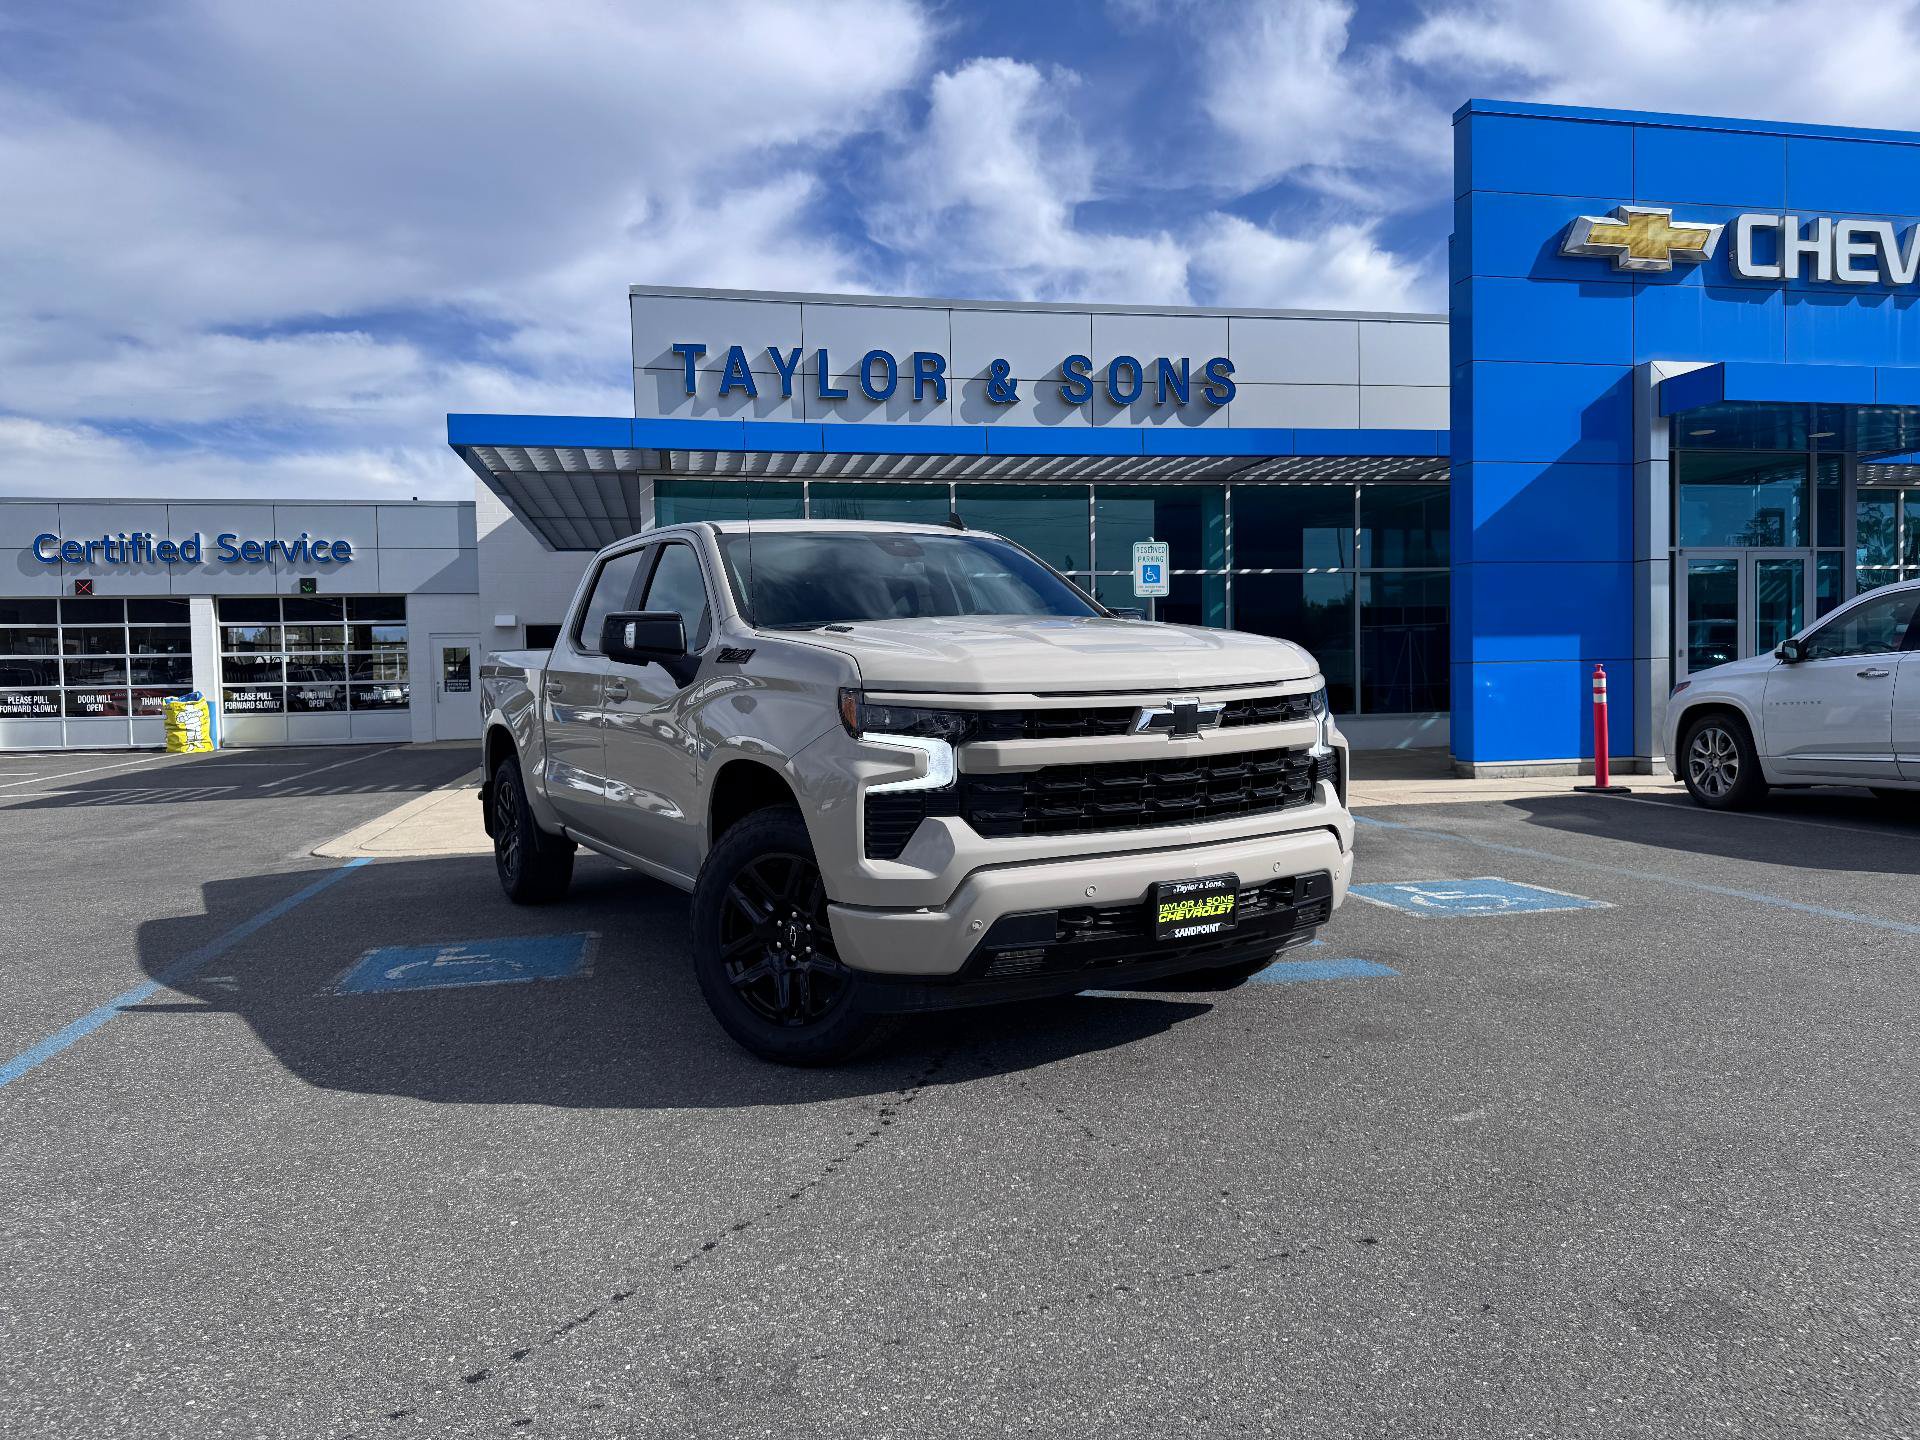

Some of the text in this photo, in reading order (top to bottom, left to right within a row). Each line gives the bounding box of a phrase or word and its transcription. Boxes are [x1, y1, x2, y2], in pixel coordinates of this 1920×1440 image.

[672, 343, 1236, 405] TAYLOR & SONS
[32, 532, 353, 564] Certified Service
[7, 695, 50, 705] PLEASE PULL
[77, 695, 94, 704] DOOR
[95, 694, 112, 704] WILL
[233, 692, 273, 701] PLEASE PULL
[0, 704, 58, 713] FORWARD SLOWLY
[86, 704, 104, 712] OPEN
[225, 700, 280, 710] FORWARD SLOWLY
[308, 699, 325, 708] OPEN
[1175, 883, 1198, 893] Taylor
[1204, 880, 1222, 889] Sons
[1160, 894, 1235, 912] TAYLOR & SONS
[1158, 904, 1234, 922] CHEVROLET
[1174, 922, 1221, 938] SANDPOINT
